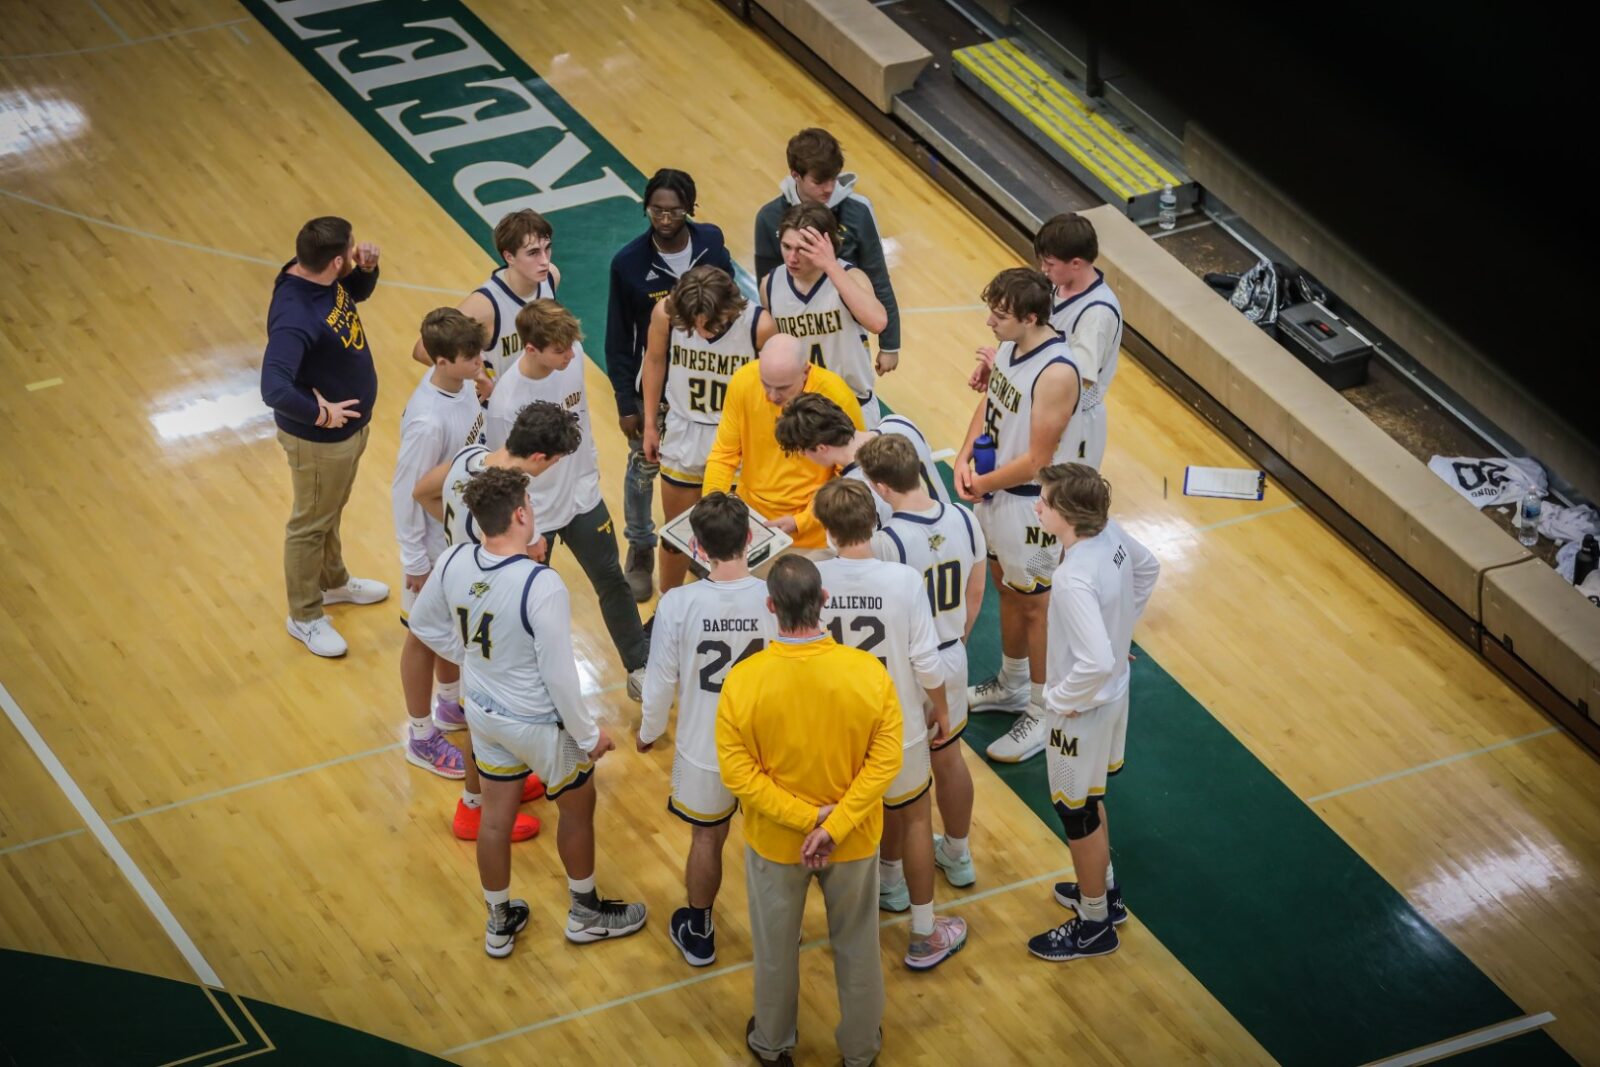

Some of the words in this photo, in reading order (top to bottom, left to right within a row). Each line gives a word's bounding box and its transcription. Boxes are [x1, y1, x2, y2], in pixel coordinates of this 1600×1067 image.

[688, 377, 727, 413] 20
[1024, 526, 1057, 548] NM
[924, 560, 961, 617] 10
[456, 606, 494, 660] 14
[702, 618, 758, 632] BABCOCK
[1049, 728, 1079, 757] NM
